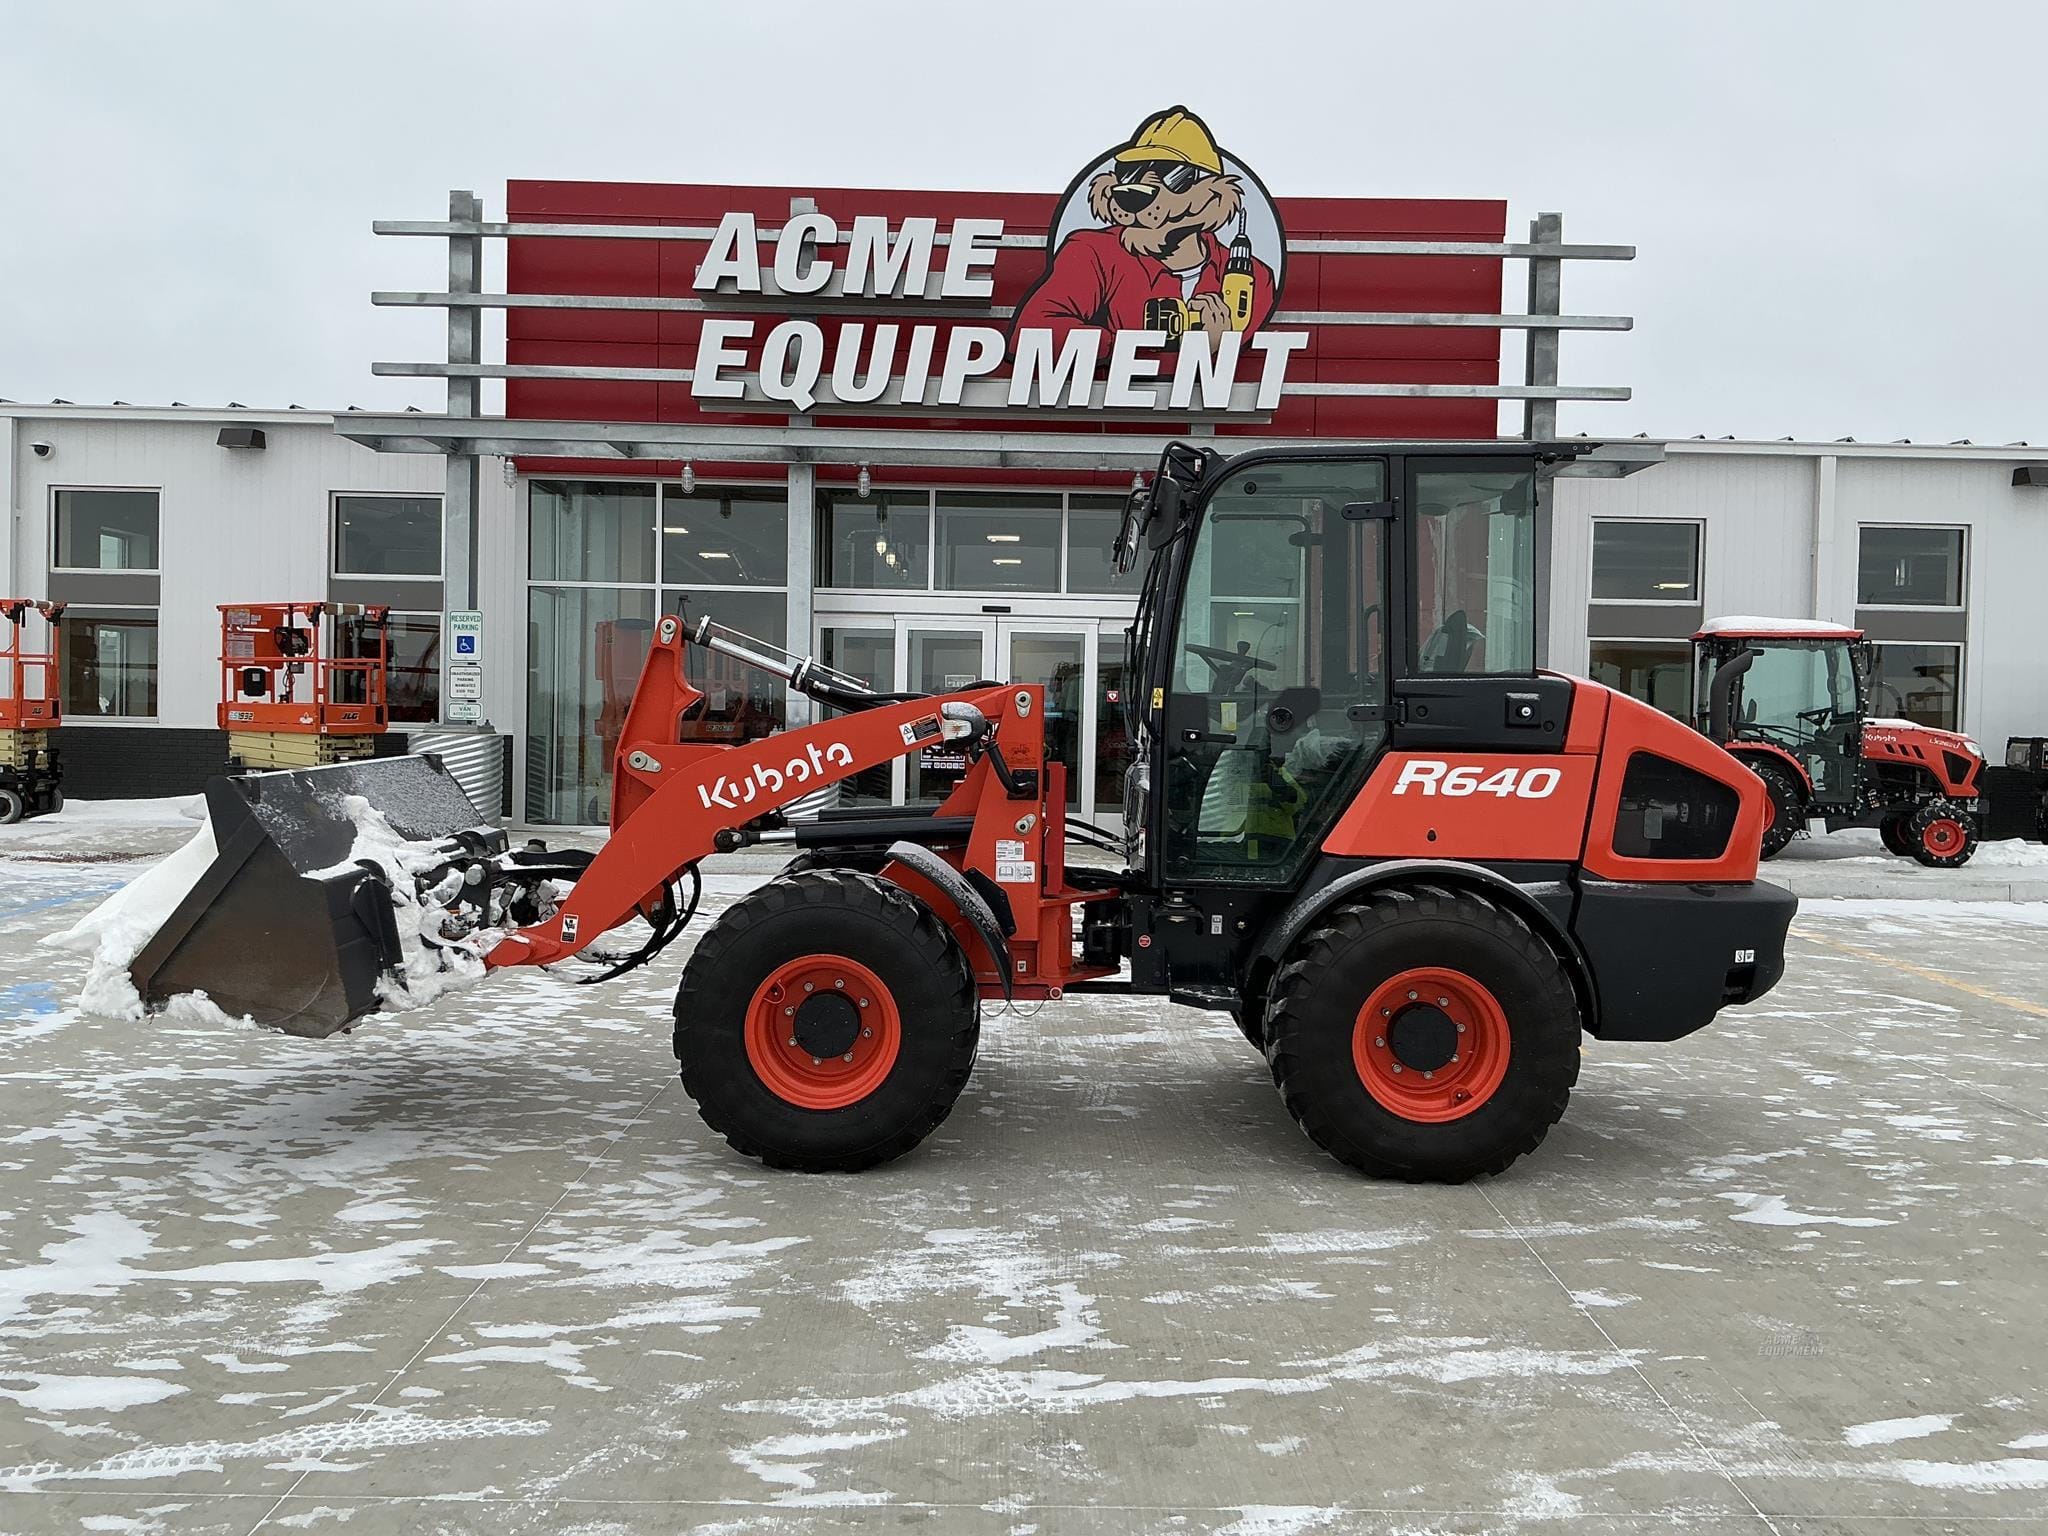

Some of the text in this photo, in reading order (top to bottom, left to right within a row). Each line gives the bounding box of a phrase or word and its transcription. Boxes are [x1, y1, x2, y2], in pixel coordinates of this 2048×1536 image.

[692, 211, 1005, 299] ACME
[691, 318, 1310, 412] EQUIPMENT
[451, 614, 481, 622] RESERVED
[340, 712, 360, 720] JLG
[1864, 733, 1897, 742] Kubota
[696, 742, 855, 810] Kubota
[1391, 759, 1562, 799] R640
